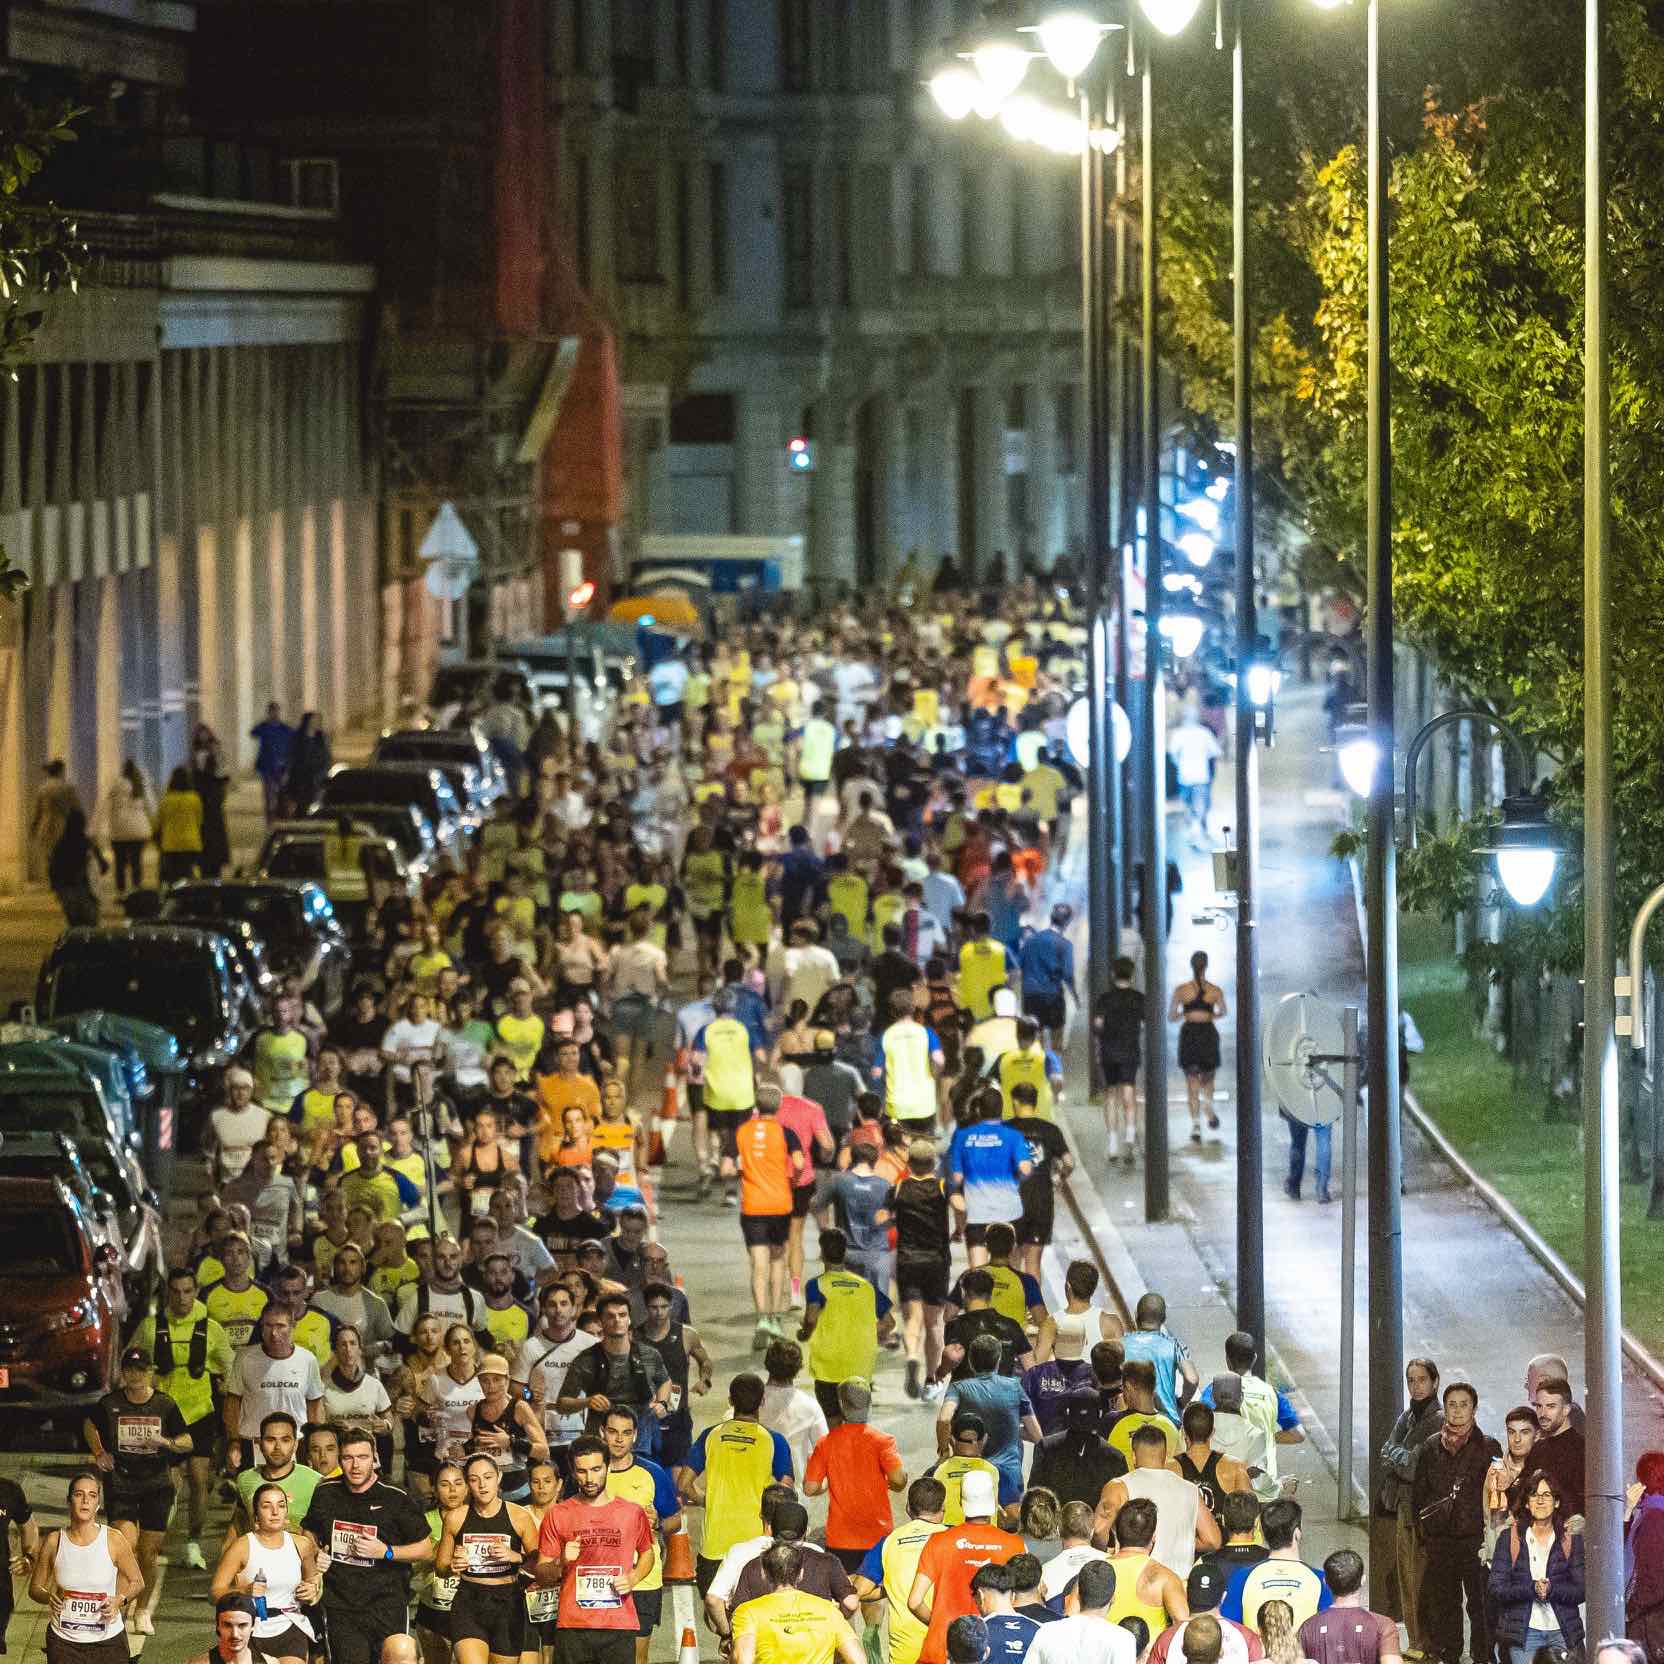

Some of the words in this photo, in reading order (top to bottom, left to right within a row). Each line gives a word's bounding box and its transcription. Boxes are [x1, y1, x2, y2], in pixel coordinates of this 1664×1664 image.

[339, 1531, 359, 1545] 108
[585, 1577, 612, 1590] 7884
[71, 1600, 97, 1614] 8908
